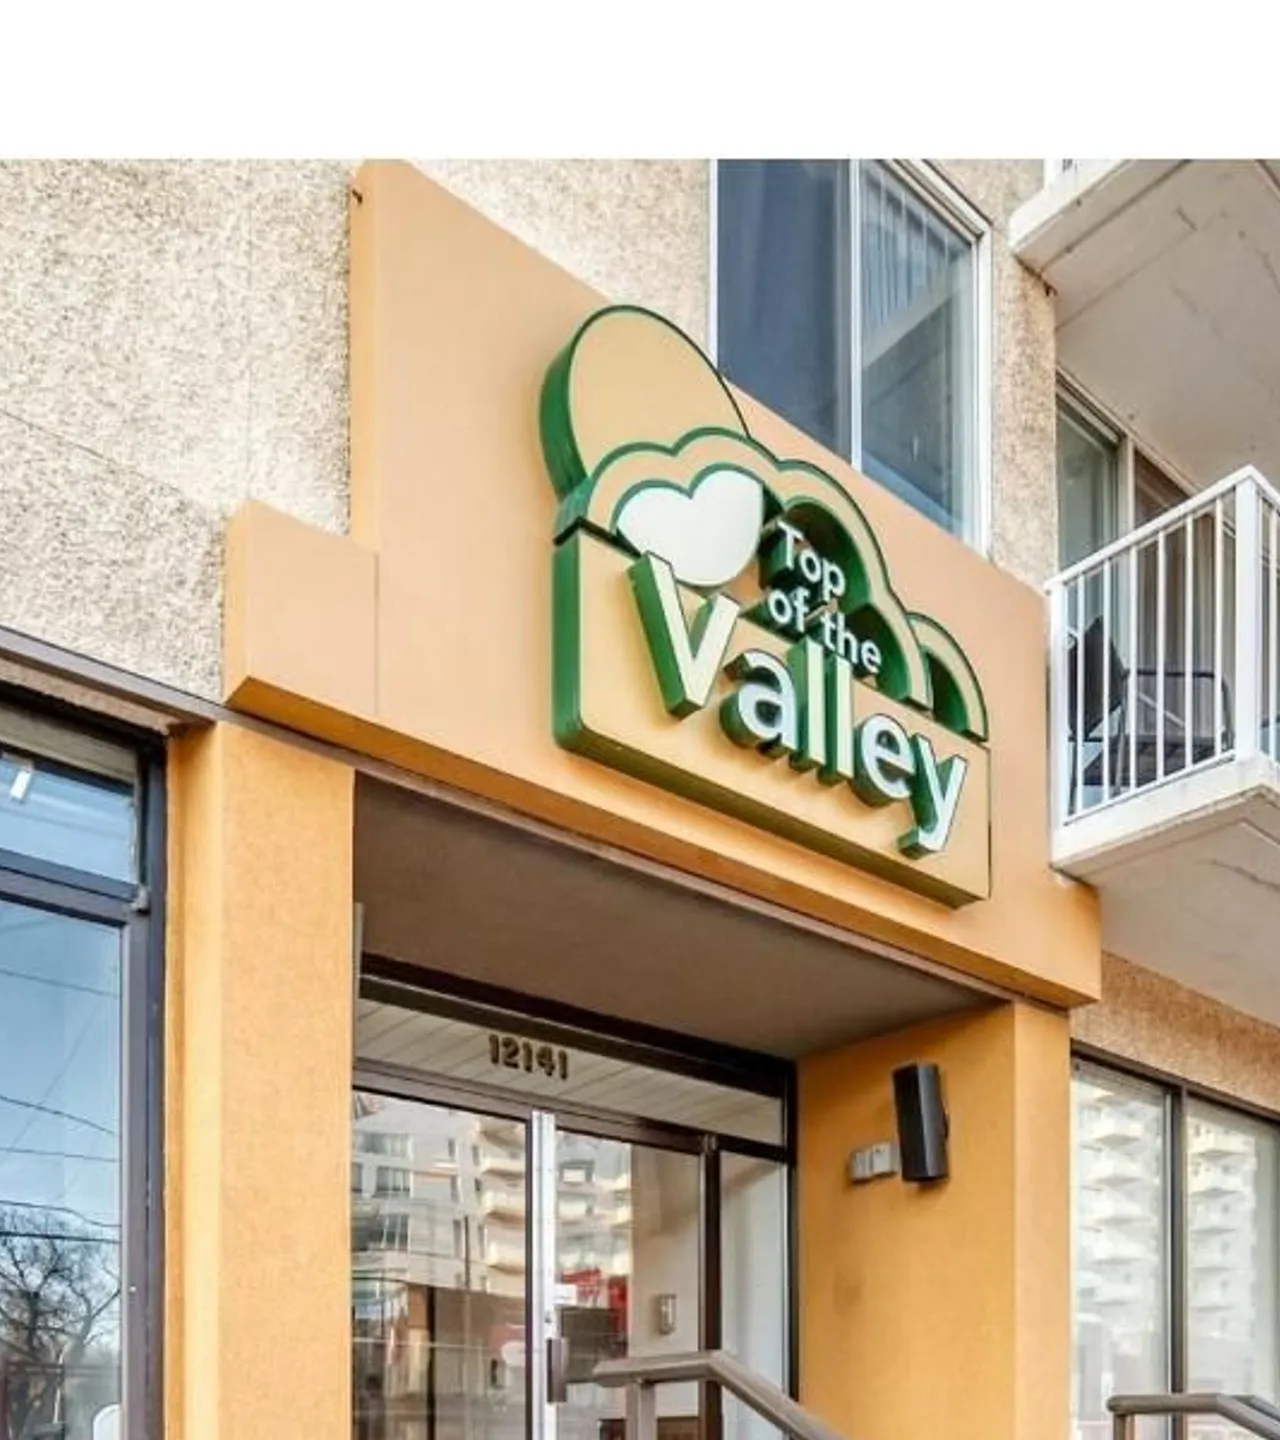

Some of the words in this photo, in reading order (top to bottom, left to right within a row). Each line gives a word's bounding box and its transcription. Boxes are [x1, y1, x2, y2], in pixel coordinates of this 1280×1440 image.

[777, 519, 845, 602] Top
[768, 585, 810, 633] of
[820, 610, 882, 674] the
[630, 551, 967, 856] Valley
[488, 1033, 568, 1080] 12141
